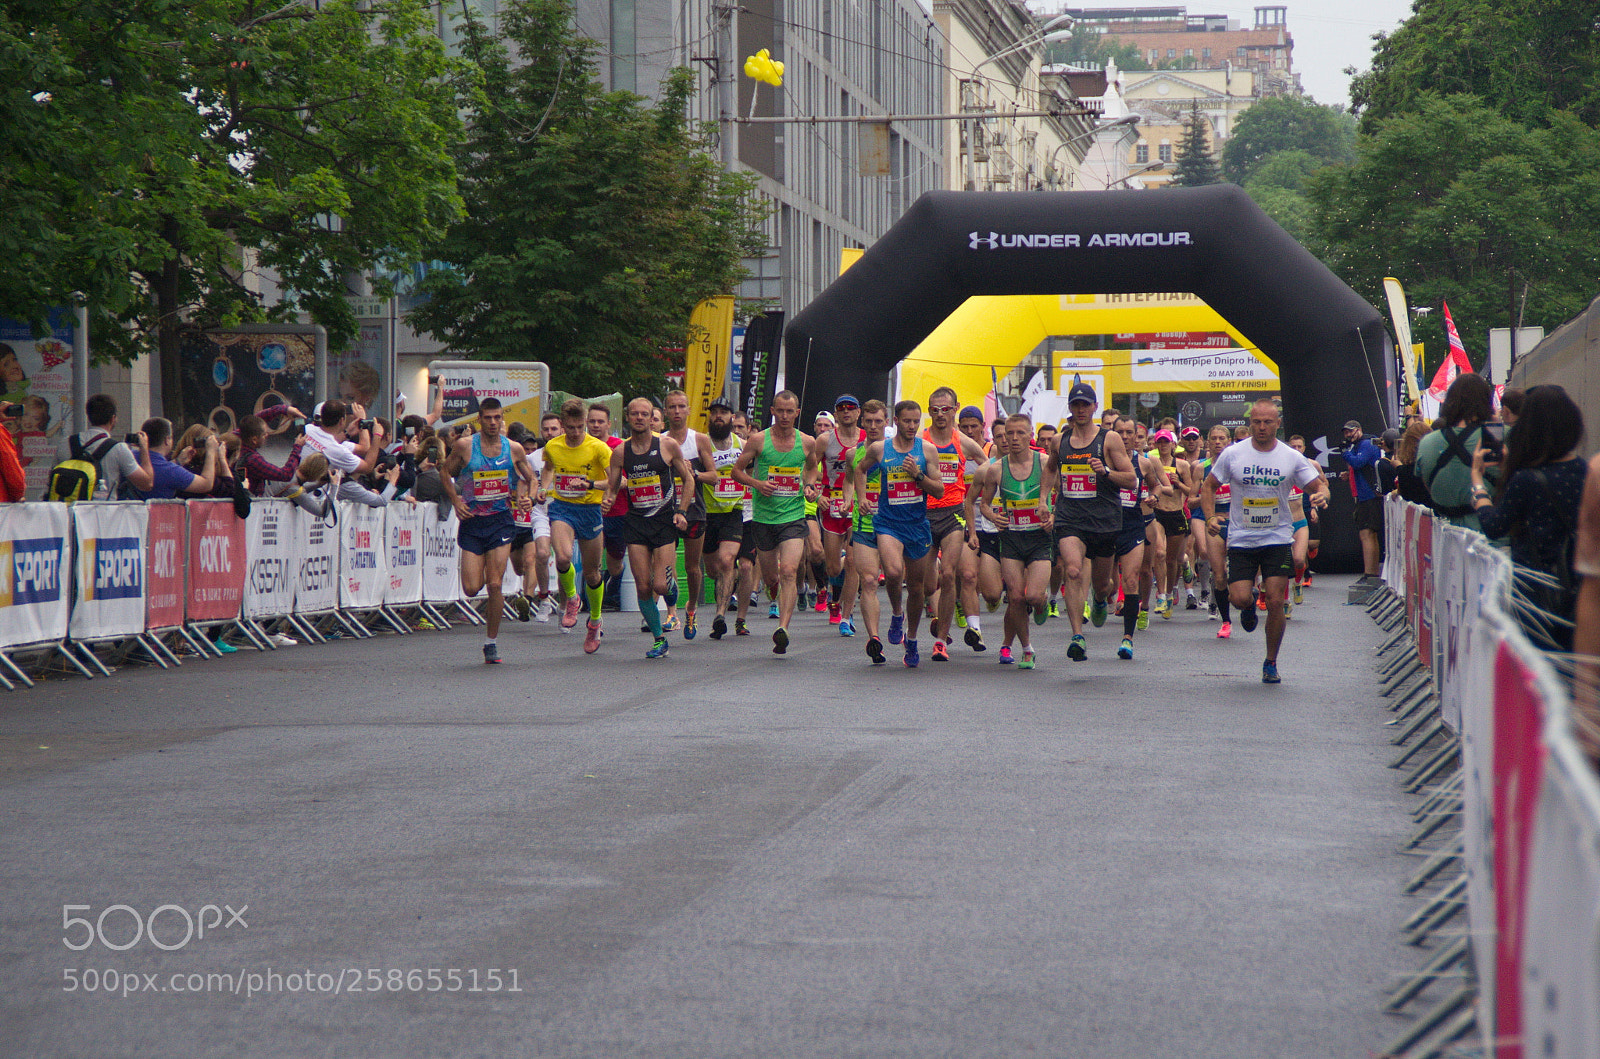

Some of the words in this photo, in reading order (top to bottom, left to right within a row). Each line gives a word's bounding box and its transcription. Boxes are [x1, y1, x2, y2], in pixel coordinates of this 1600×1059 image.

[1001, 233, 1081, 248] UNDER
[1087, 231, 1191, 247] ARMOUR
[702, 332, 711, 354] GN
[1171, 357, 1212, 367] Interpipe
[1214, 356, 1245, 367] Dnipro
[1247, 356, 1264, 365] Ha
[747, 351, 762, 424] RBALIFE
[443, 399, 470, 408] ТАБІР
[633, 463, 649, 472] new
[628, 470, 658, 480] balance
[484, 480, 499, 489] 873
[1070, 482, 1086, 491] 474
[1242, 475, 1280, 487] steko
[1250, 515, 1272, 524] 40022
[14, 549, 59, 593] SPORT
[96, 548, 140, 589] SPORT
